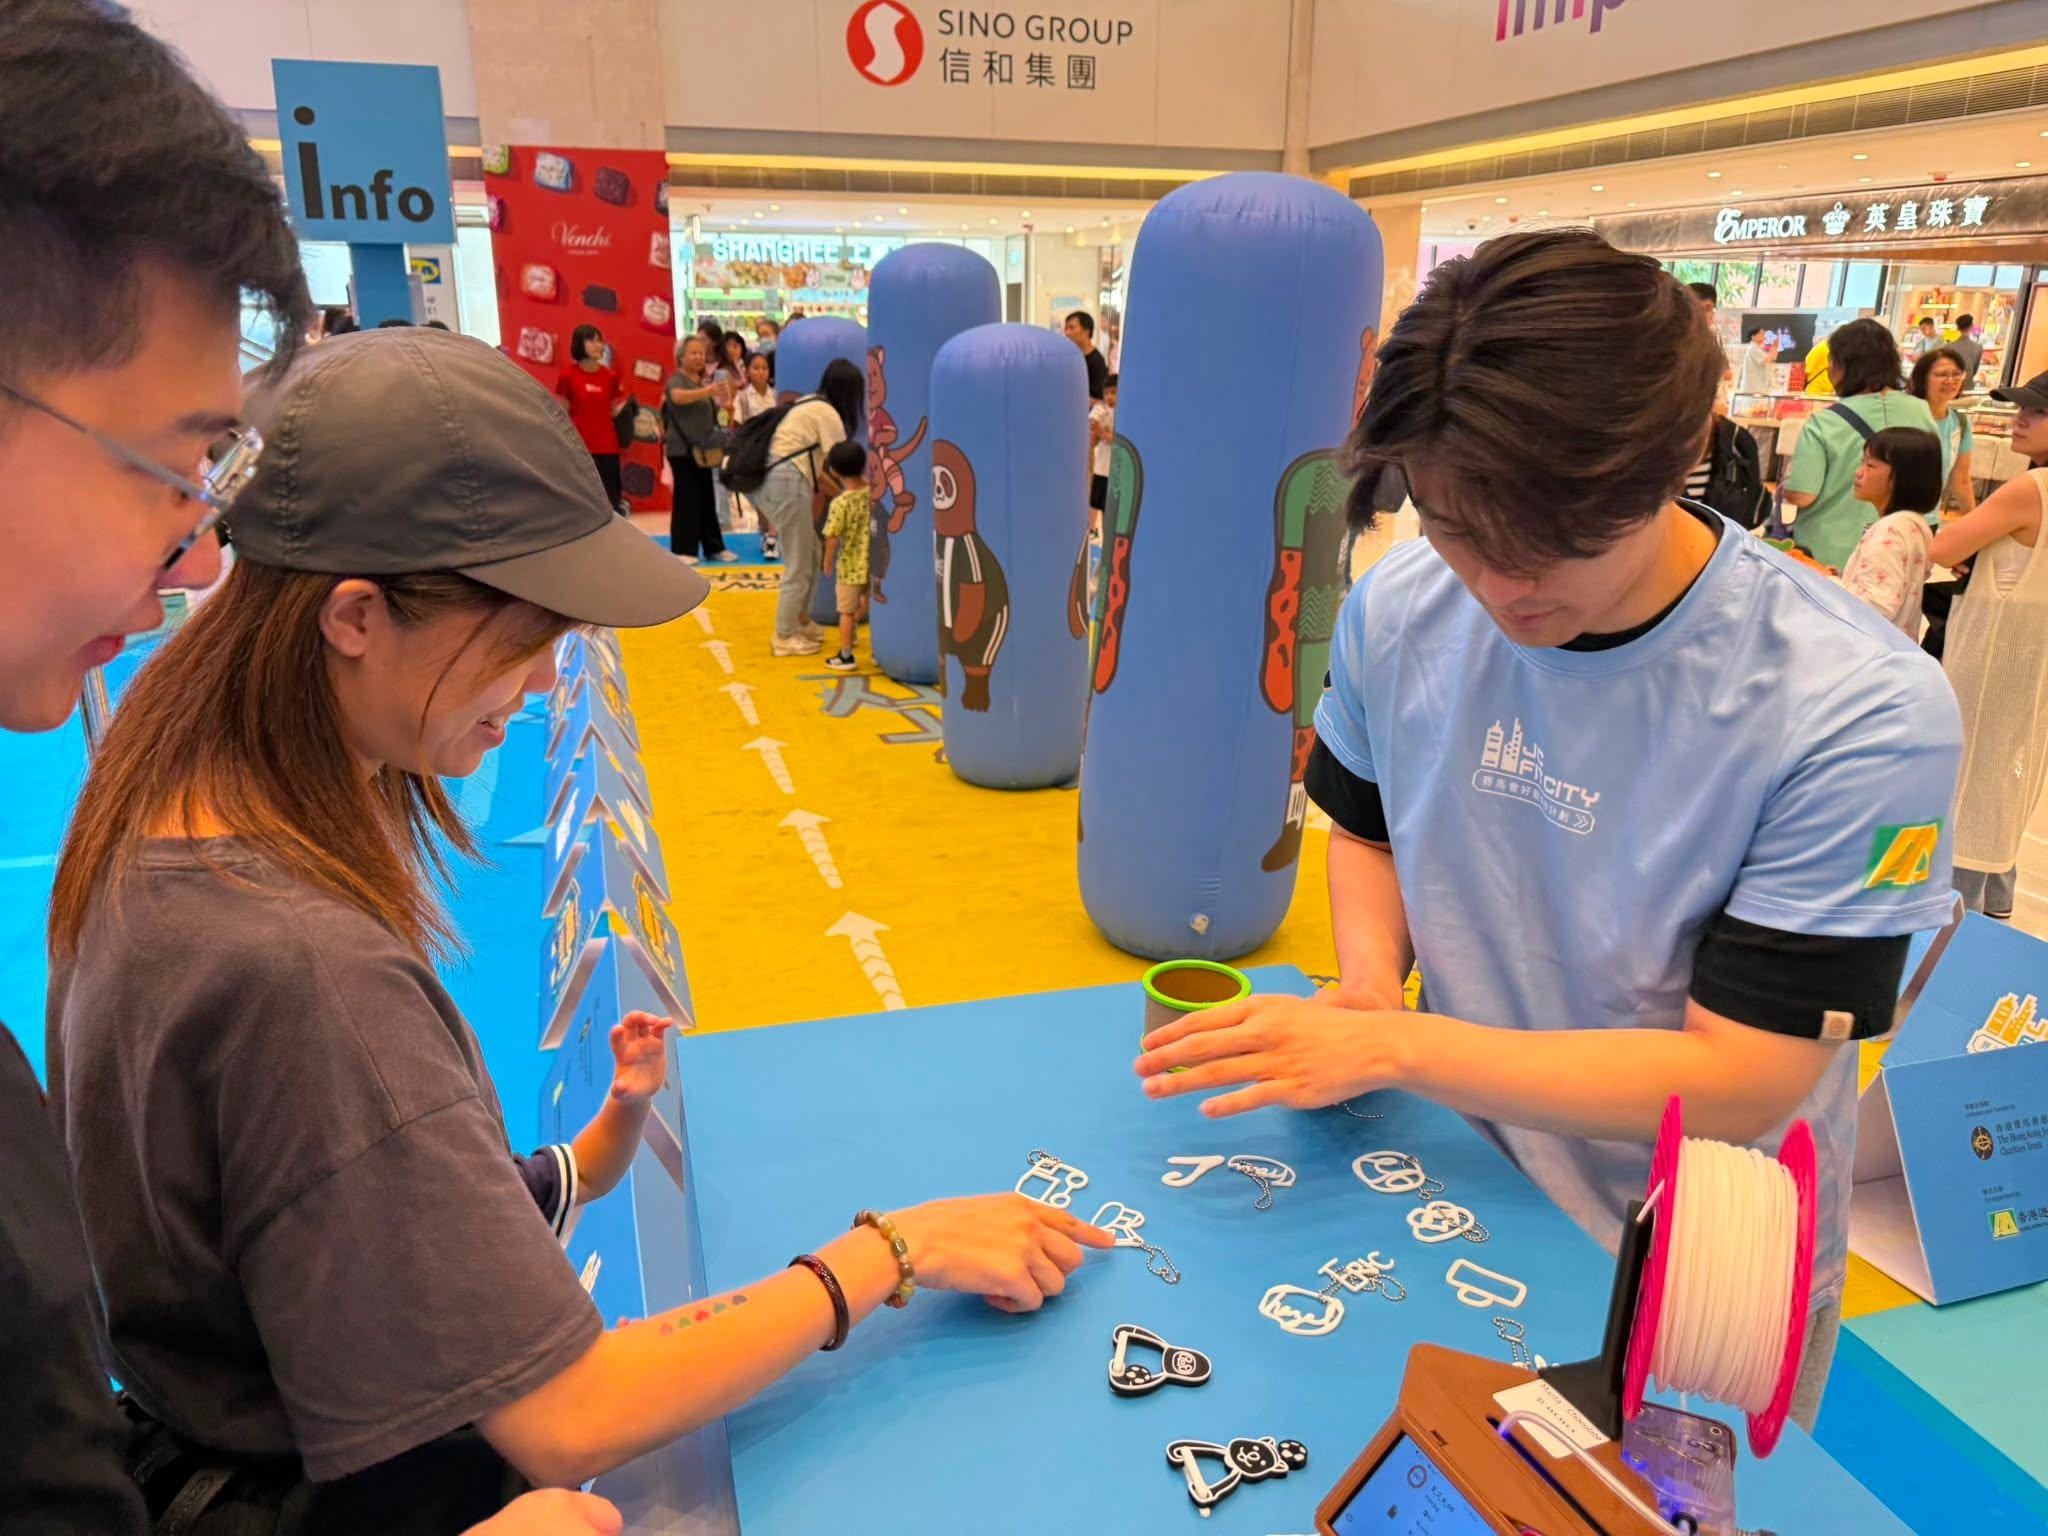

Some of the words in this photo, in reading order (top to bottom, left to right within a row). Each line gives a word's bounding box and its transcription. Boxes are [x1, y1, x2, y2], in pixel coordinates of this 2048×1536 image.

[938, 9, 1015, 39] SINO
[1025, 14, 1133, 45] GROUP
[939, 47, 1096, 90] 信和集團
[1863, 195, 1989, 233] 英皇珠寶
[712, 238, 841, 264] SHANGHEE
